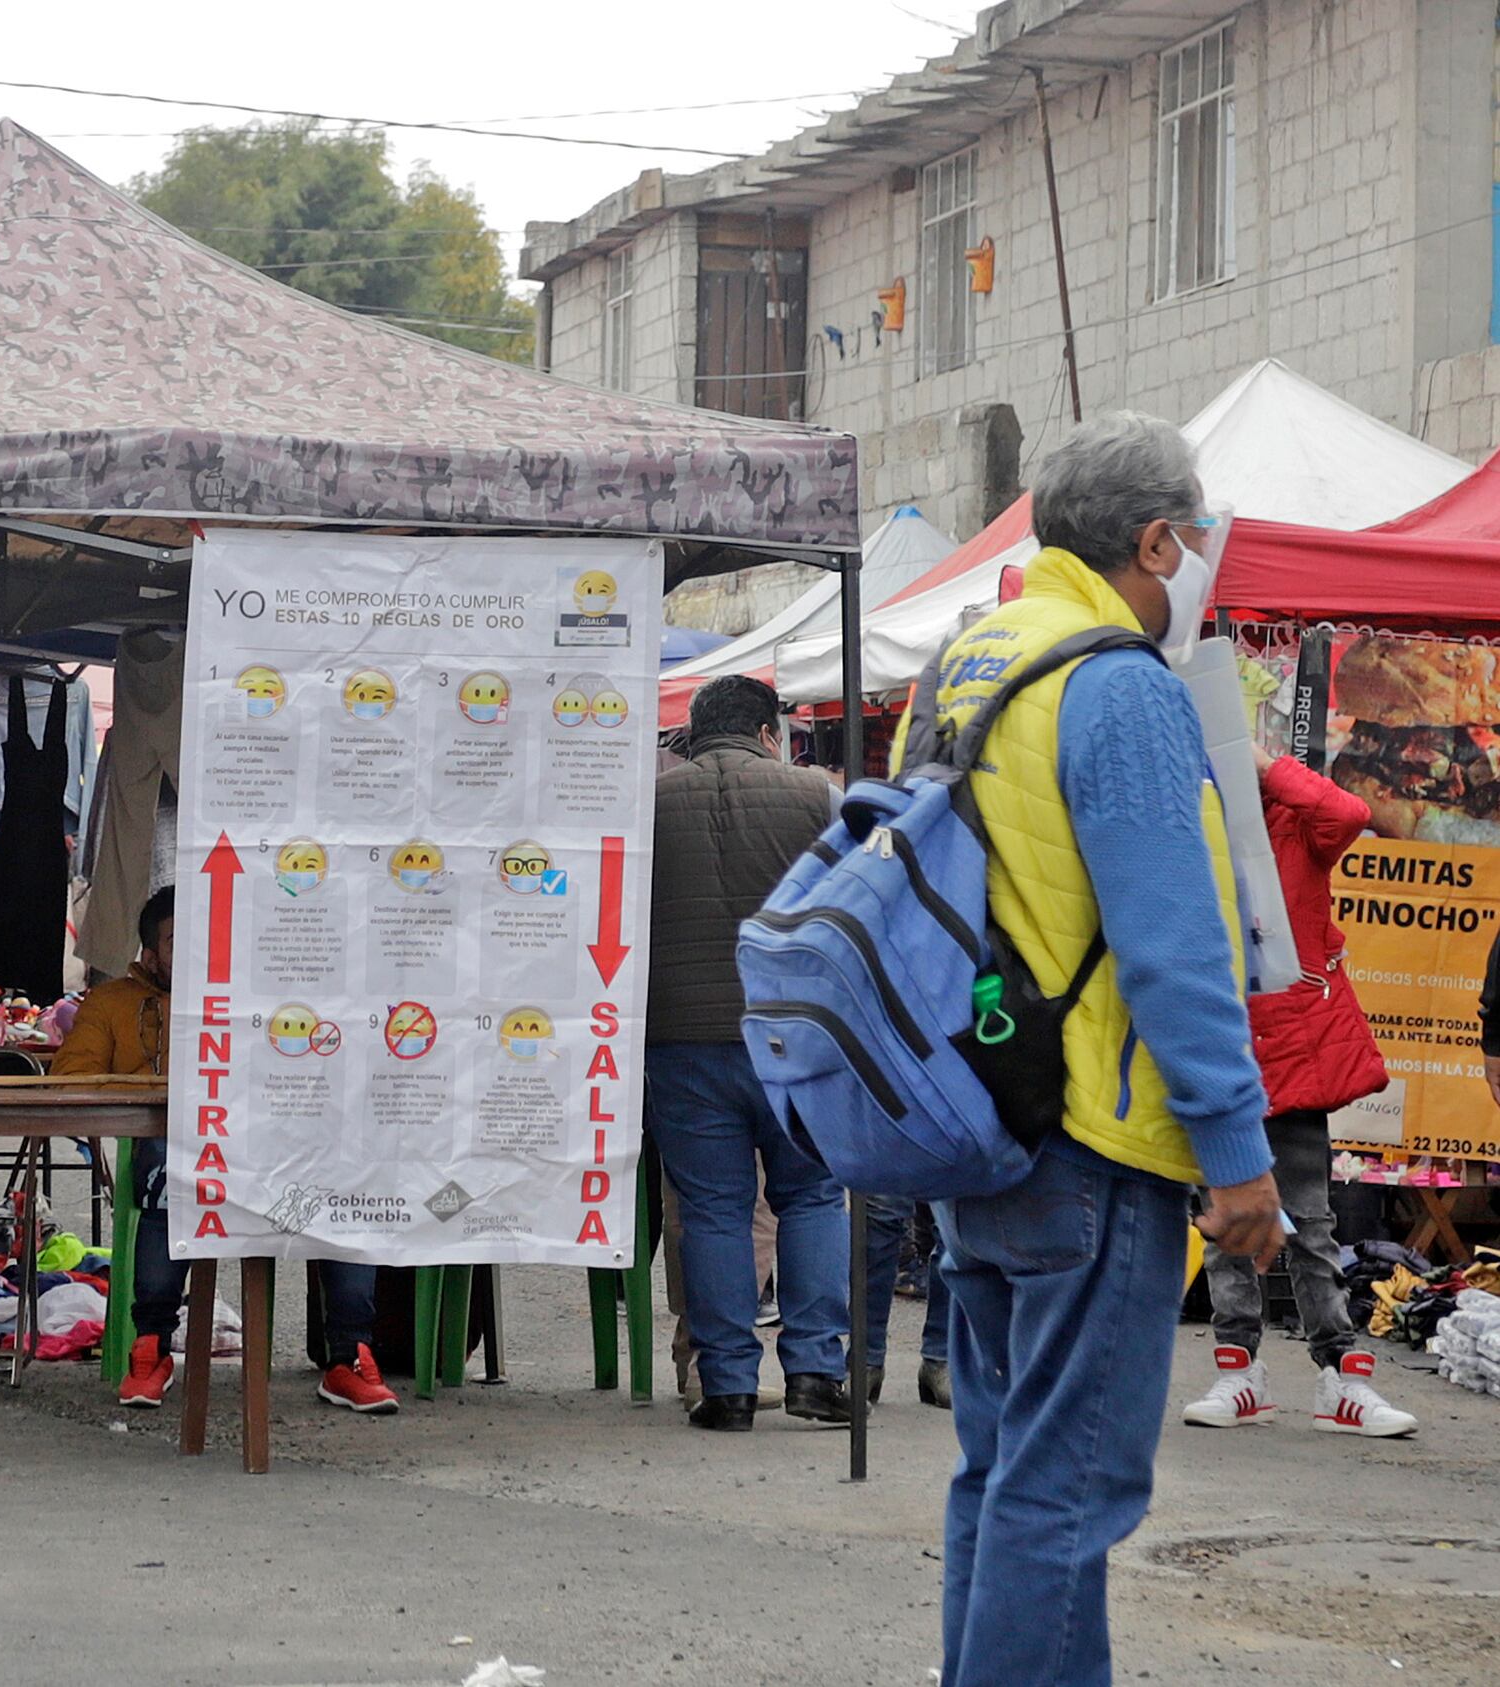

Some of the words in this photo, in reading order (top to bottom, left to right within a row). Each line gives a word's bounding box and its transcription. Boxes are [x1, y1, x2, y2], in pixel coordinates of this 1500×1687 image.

[213, 588, 266, 619] YO
[275, 588, 300, 603] ME
[306, 590, 431, 607] COMPROMETO
[435, 594, 446, 608] A
[450, 594, 525, 610] CUMPLIR
[275, 609, 330, 624] ESTAS
[341, 612, 360, 625] 10
[372, 612, 441, 627] REGLAS
[453, 614, 474, 628] DE
[486, 615, 525, 629] ORO
[209, 666, 218, 680] 1
[324, 668, 335, 683] 2
[438, 672, 448, 687] 3
[545, 672, 556, 687] 4
[1294, 685, 1312, 767] PREGUN
[258, 839, 269, 853] 5
[369, 848, 380, 862] 6
[488, 851, 497, 865] 7
[1341, 853, 1474, 888] CEMITAS
[1346, 963, 1412, 987] liciosas
[1417, 972, 1484, 992] cemitas
[252, 1013, 262, 1028] 8
[369, 1014, 379, 1029] 9
[475, 1015, 492, 1030] 10
[1406, 1017, 1433, 1028] CON
[1438, 1019, 1478, 1032] TODAS
[1372, 1029, 1394, 1040] IAS
[1398, 1031, 1432, 1043] ANTE
[1435, 1034, 1451, 1045] LA
[1385, 1057, 1422, 1073] ANOS
[1425, 1061, 1442, 1075] EN
[1445, 1063, 1463, 1076] LA
[1467, 1065, 1486, 1079] ZO
[1348, 1100, 1402, 1116] ZINGO
[194, 996, 231, 1238] ENTRADA
[575, 1001, 620, 1245] SALIDA
[1413, 1136, 1431, 1151] 22
[1436, 1138, 1472, 1154] 1230
[328, 1193, 406, 1207] Gobierno
[330, 1209, 347, 1223] de
[352, 1209, 412, 1223] Puebla
[463, 1226, 478, 1235] de
